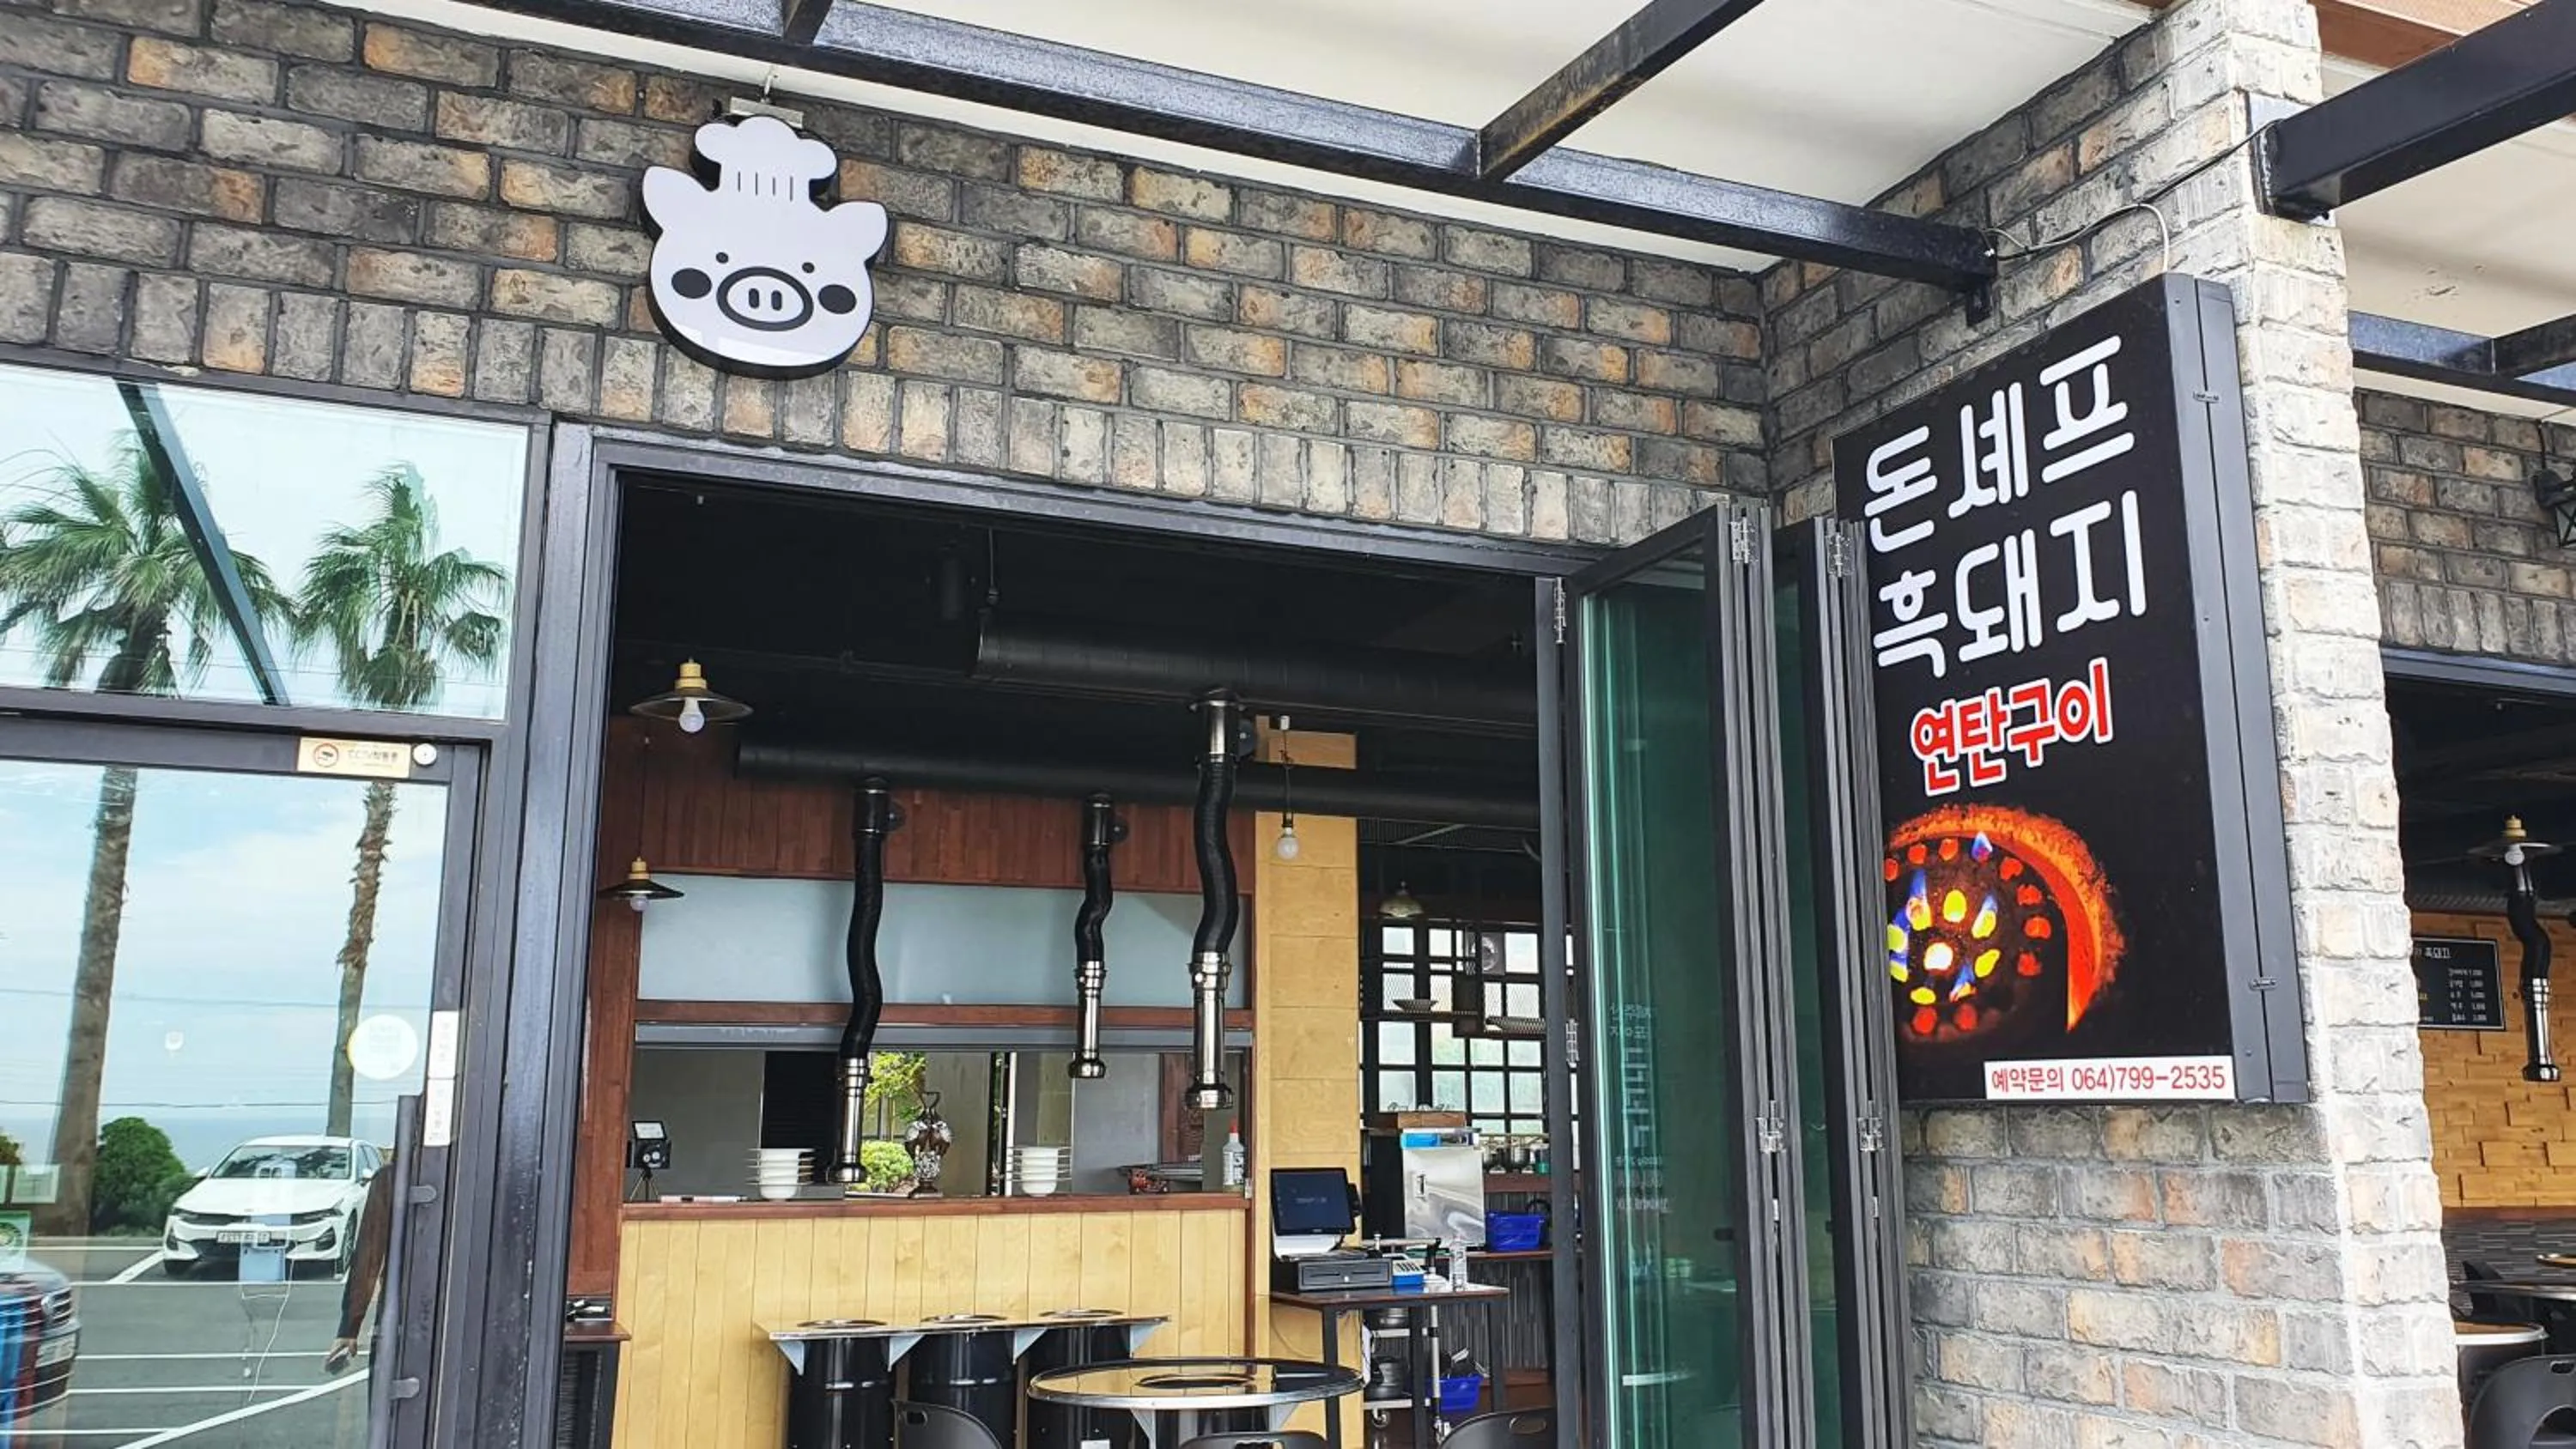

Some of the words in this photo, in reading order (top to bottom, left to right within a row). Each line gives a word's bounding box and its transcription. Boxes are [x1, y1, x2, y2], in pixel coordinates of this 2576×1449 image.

[1863, 335, 2136, 553] 돈셰프
[1874, 489, 2147, 678] 흑돼지
[1911, 657, 2114, 796] 연탄구이
[1990, 1067, 2065, 1094] 예약문의
[2071, 1064, 2226, 1092] 064)799-2535
